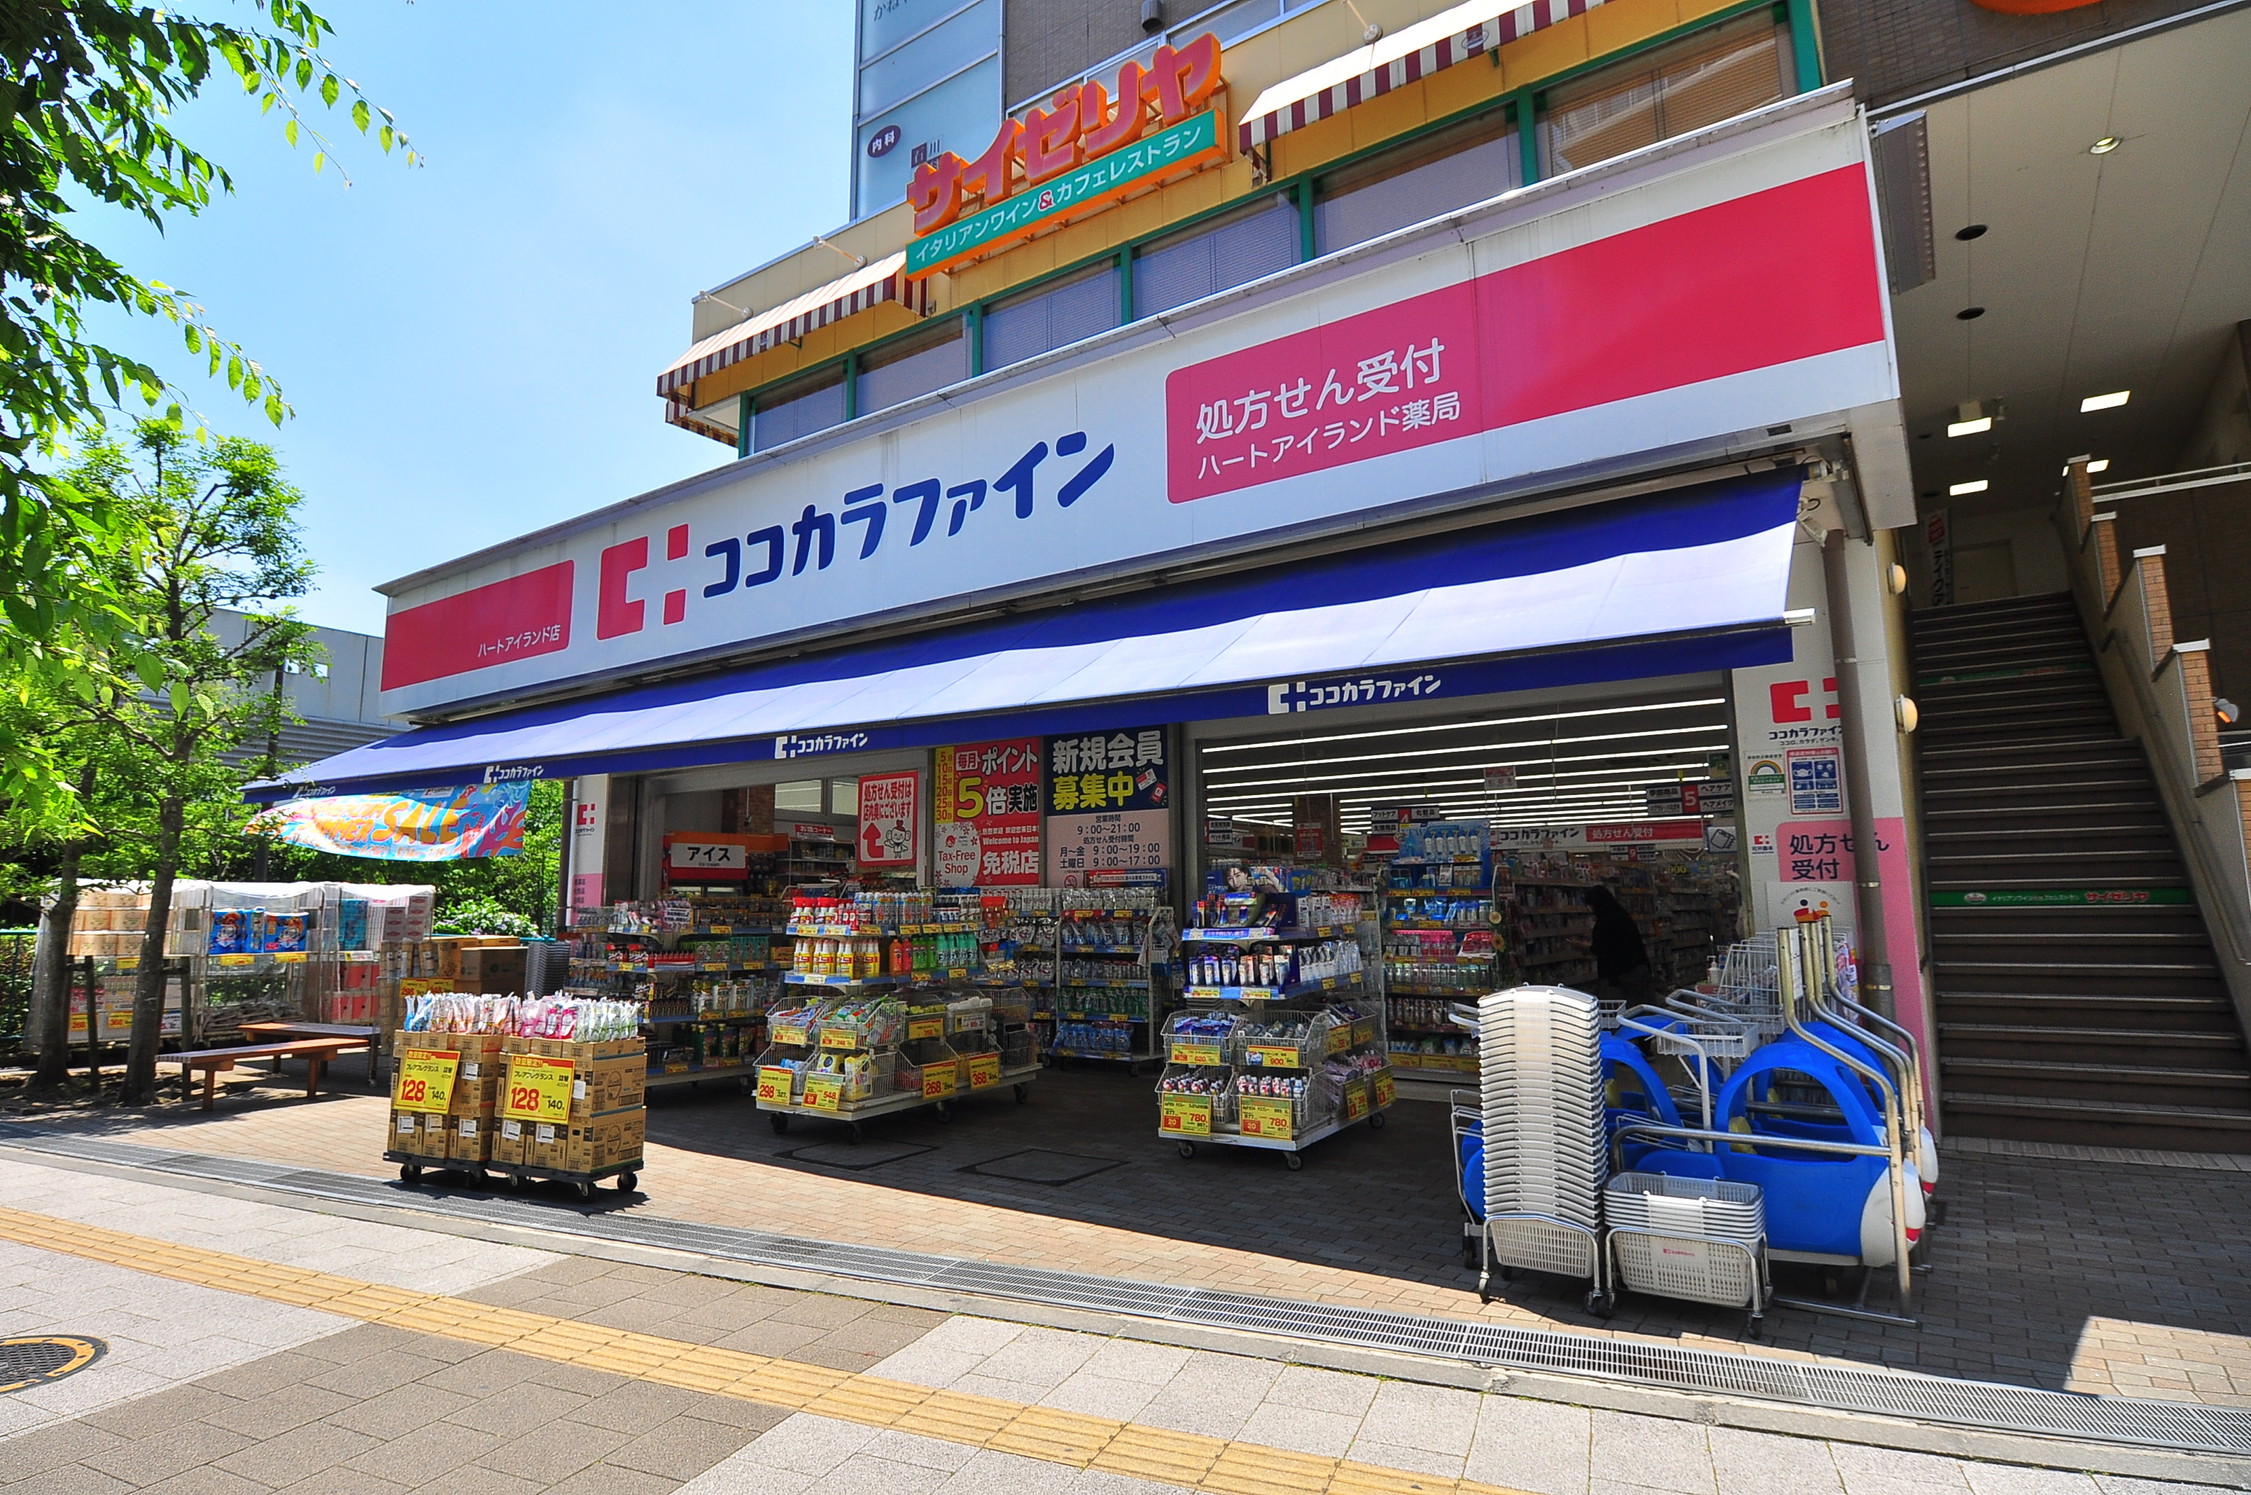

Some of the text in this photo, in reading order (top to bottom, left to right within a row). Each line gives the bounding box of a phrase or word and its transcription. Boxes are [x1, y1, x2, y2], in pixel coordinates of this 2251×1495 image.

[872, 130, 895, 153] 内科
[907, 32, 1220, 234] サイゼリヤ
[916, 126, 1202, 261] イタリアンワイン&カフェレストラン
[1196, 337, 1445, 444] 処方せん受付
[1197, 391, 1461, 480] ハートアイランド薬局
[703, 431, 1115, 599] ココカラファイン
[478, 624, 561, 658] ハートアイランド店
[1309, 675, 1441, 705] ココカラファイン
[1769, 725, 1842, 740] ココカラファイ
[797, 733, 868, 754] ココカラファイン
[1053, 730, 1164, 774] 新規会員
[959, 744, 1038, 775] 毎月 ポイント
[498, 765, 544, 780] ココカラファイン
[864, 781, 911, 802] 処方せん受付は
[957, 777, 1038, 818] 5倍実施
[1053, 771, 1134, 811] 募集中
[1684, 791, 1697, 806] 5
[1701, 784, 1731, 792] ヘアケア
[372, 801, 459, 845] SALE
[1500, 827, 1580, 840] ココカラファイン
[1592, 826, 1653, 838] 処方せん受付
[687, 846, 730, 861] アイス
[938, 850, 976, 861] Tax-Free
[983, 850, 1039, 875] 免税店
[1060, 858, 1085, 868] 土曜日
[945, 863, 968, 875] Shop
[1792, 858, 1840, 880] 受付
[2085, 891, 2149, 902] サイゼリヤ
[926, 1081, 942, 1095] 268
[972, 1072, 987, 1085] 368
[402, 1079, 426, 1102] 128
[432, 1091, 445, 1100] 140
[511, 1087, 540, 1111] 128
[547, 1100, 563, 1110] 140
[1190, 1113, 1206, 1122] 780
[1270, 1117, 1287, 1127] 780
